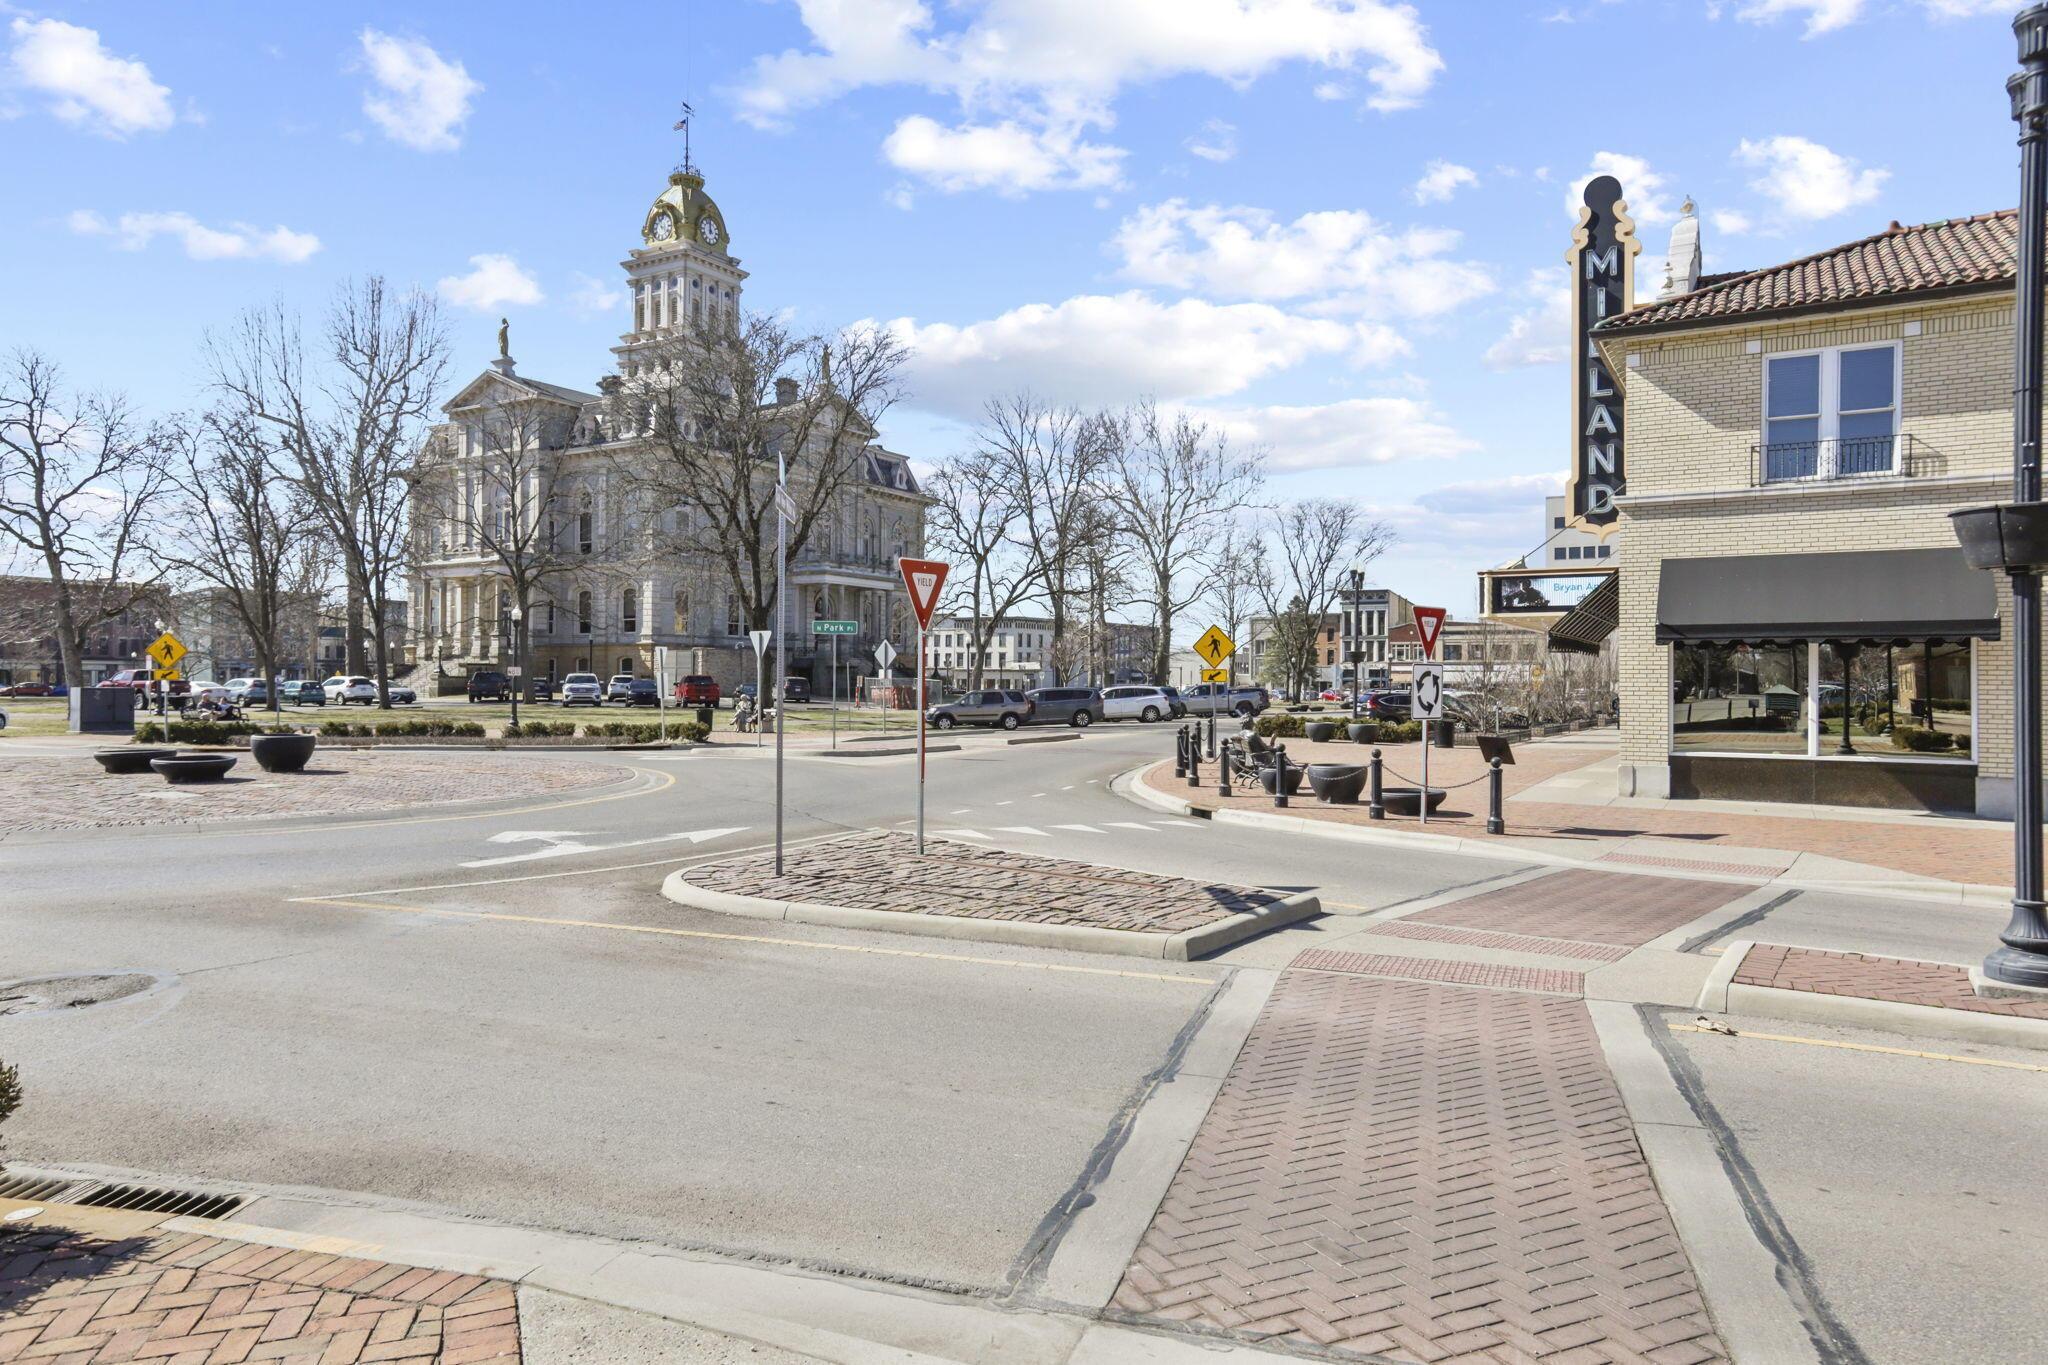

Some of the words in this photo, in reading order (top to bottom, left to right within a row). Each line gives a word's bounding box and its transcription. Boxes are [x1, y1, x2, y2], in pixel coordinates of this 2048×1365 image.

[917, 577, 933, 587] YIELD
[1553, 583, 1583, 594] Bryan
[824, 623, 844, 632] Park
